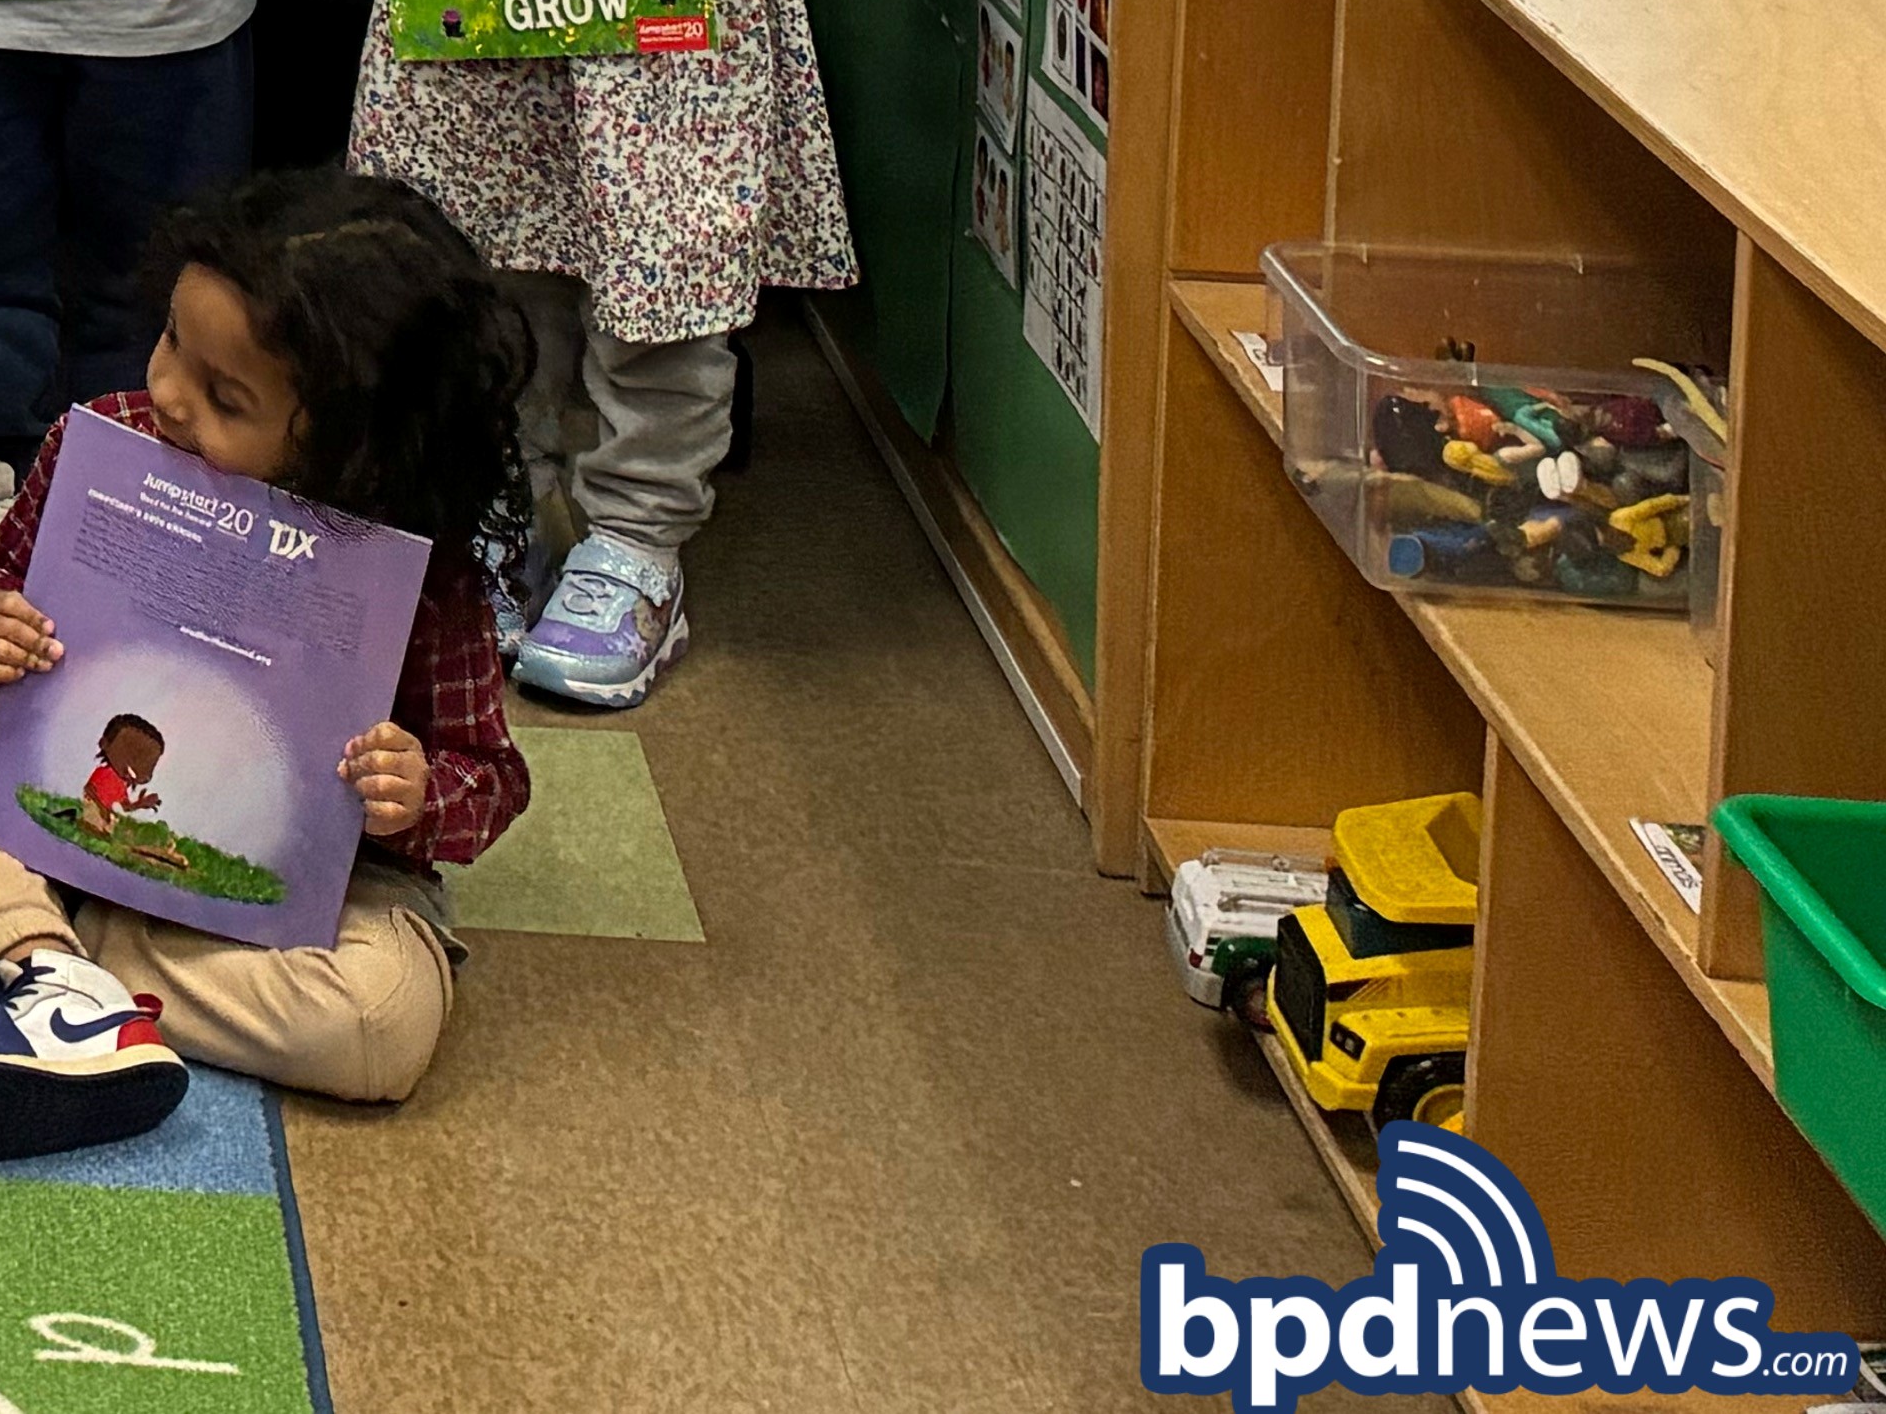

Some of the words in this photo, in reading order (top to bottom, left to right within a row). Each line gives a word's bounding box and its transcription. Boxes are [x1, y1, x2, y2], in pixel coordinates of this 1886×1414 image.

[143, 472, 218, 518] Jumpstart
[217, 502, 254, 535] 20
[269, 519, 319, 560] TJX
